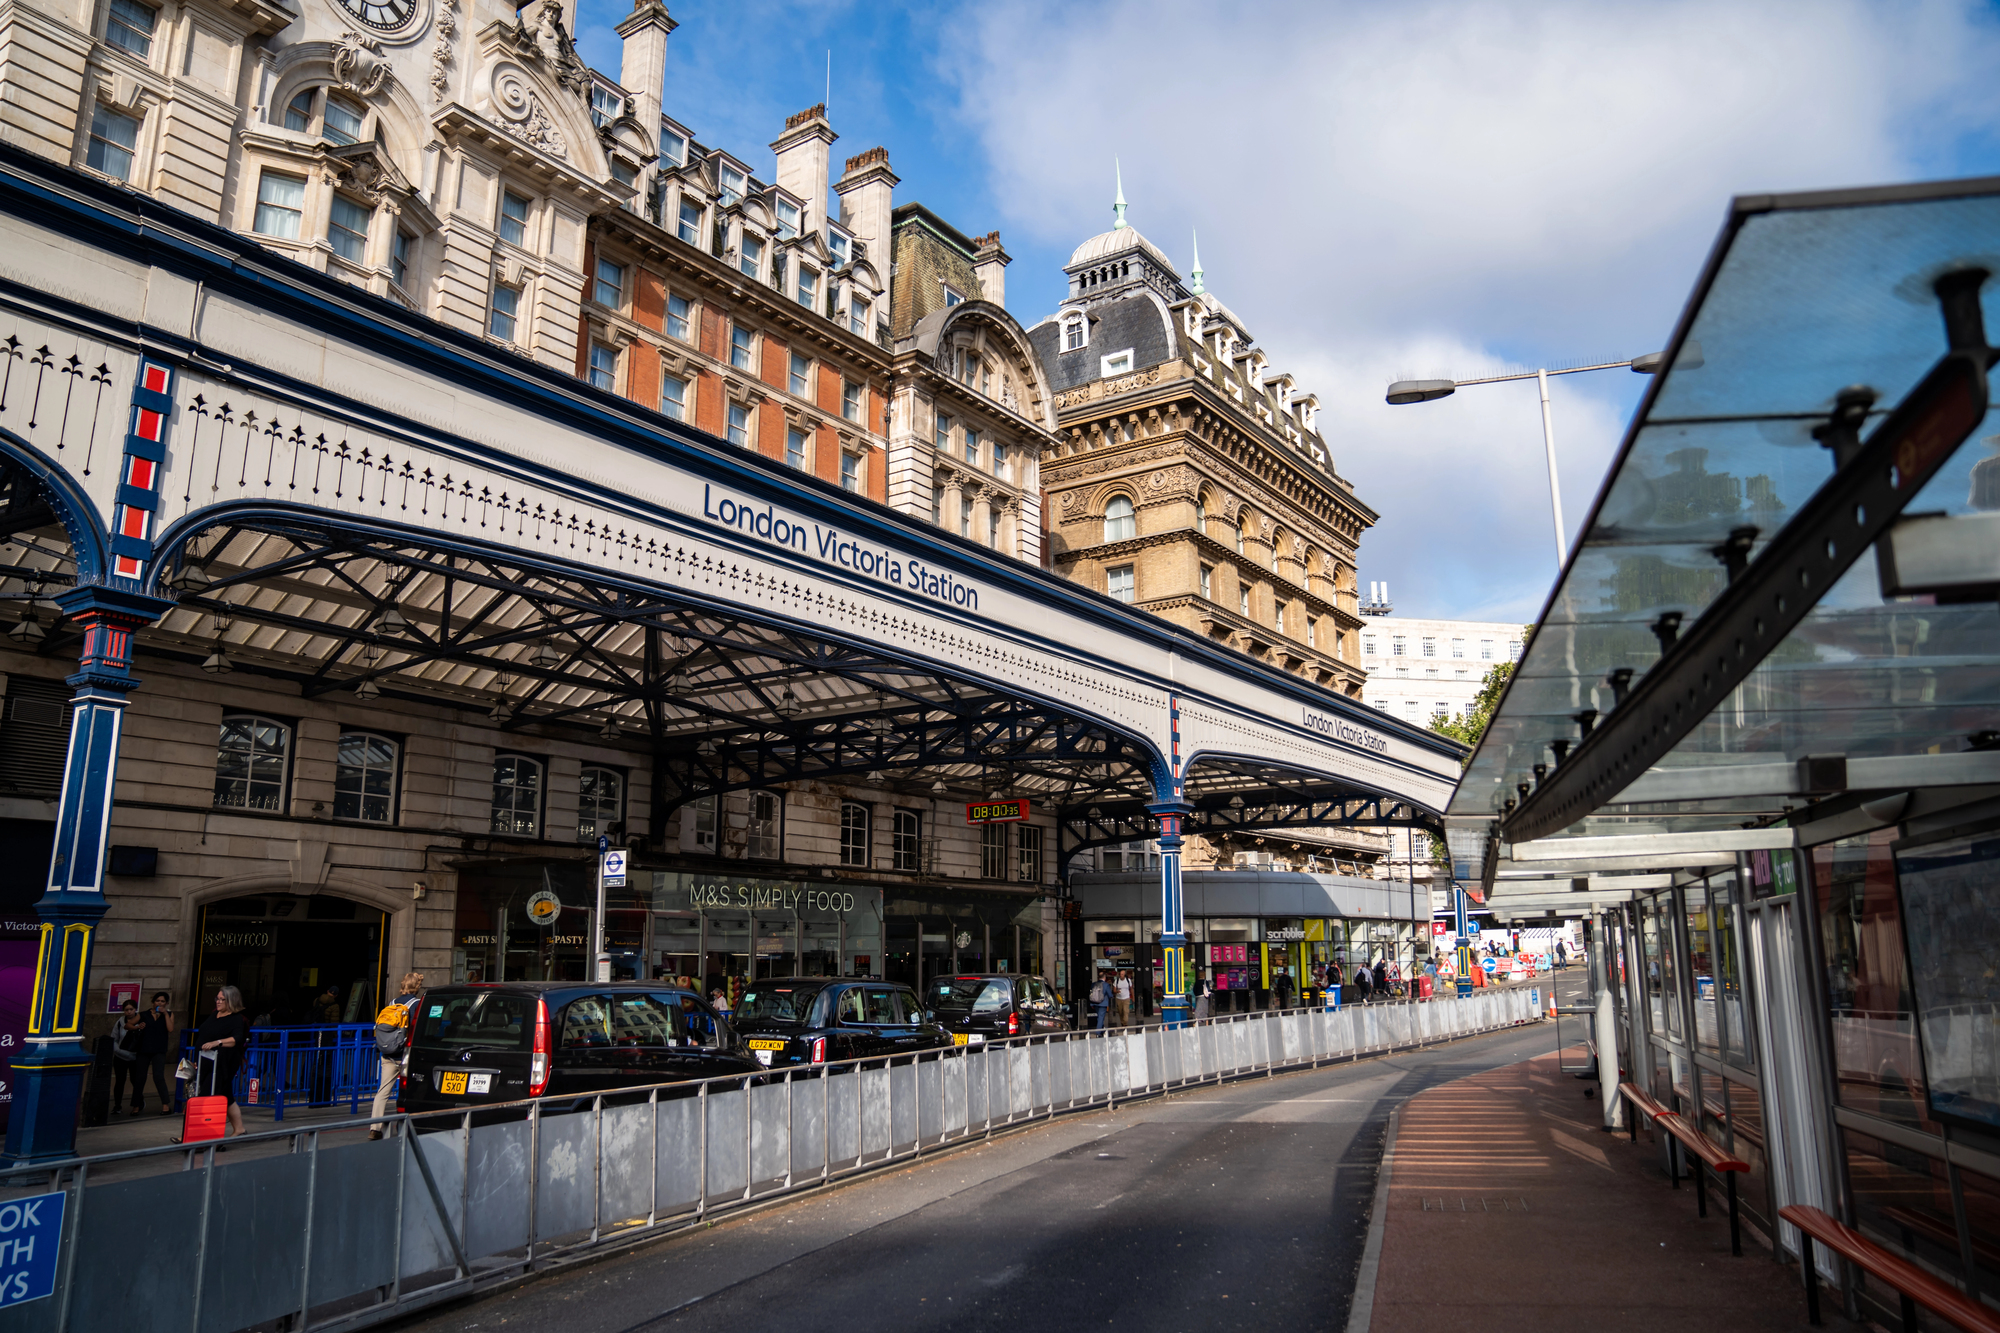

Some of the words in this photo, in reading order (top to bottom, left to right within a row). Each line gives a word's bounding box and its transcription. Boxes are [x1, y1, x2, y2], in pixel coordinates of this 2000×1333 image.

[703, 483, 807, 551] London
[815, 525, 902, 584] Victoria
[908, 560, 978, 610] Station
[1302, 707, 1334, 735] London
[1334, 719, 1363, 744] Victoria
[1363, 730, 1388, 753] Station
[535, 892, 557, 900] PASTY
[690, 884, 730, 906] M&S
[737, 886, 802, 909] SIMPLY
[807, 890, 854, 912] FOOD
[537, 915, 554, 924] SHOP
[1266, 926, 1306, 939] scribbler
[468, 935, 490, 944] PASTY
[554, 935, 584, 944] PASTY
[750, 1040, 768, 1048] LG72
[768, 1041, 782, 1049] WCN
[445, 1072, 466, 1082] LD62
[0, 1200, 44, 1233] OK
